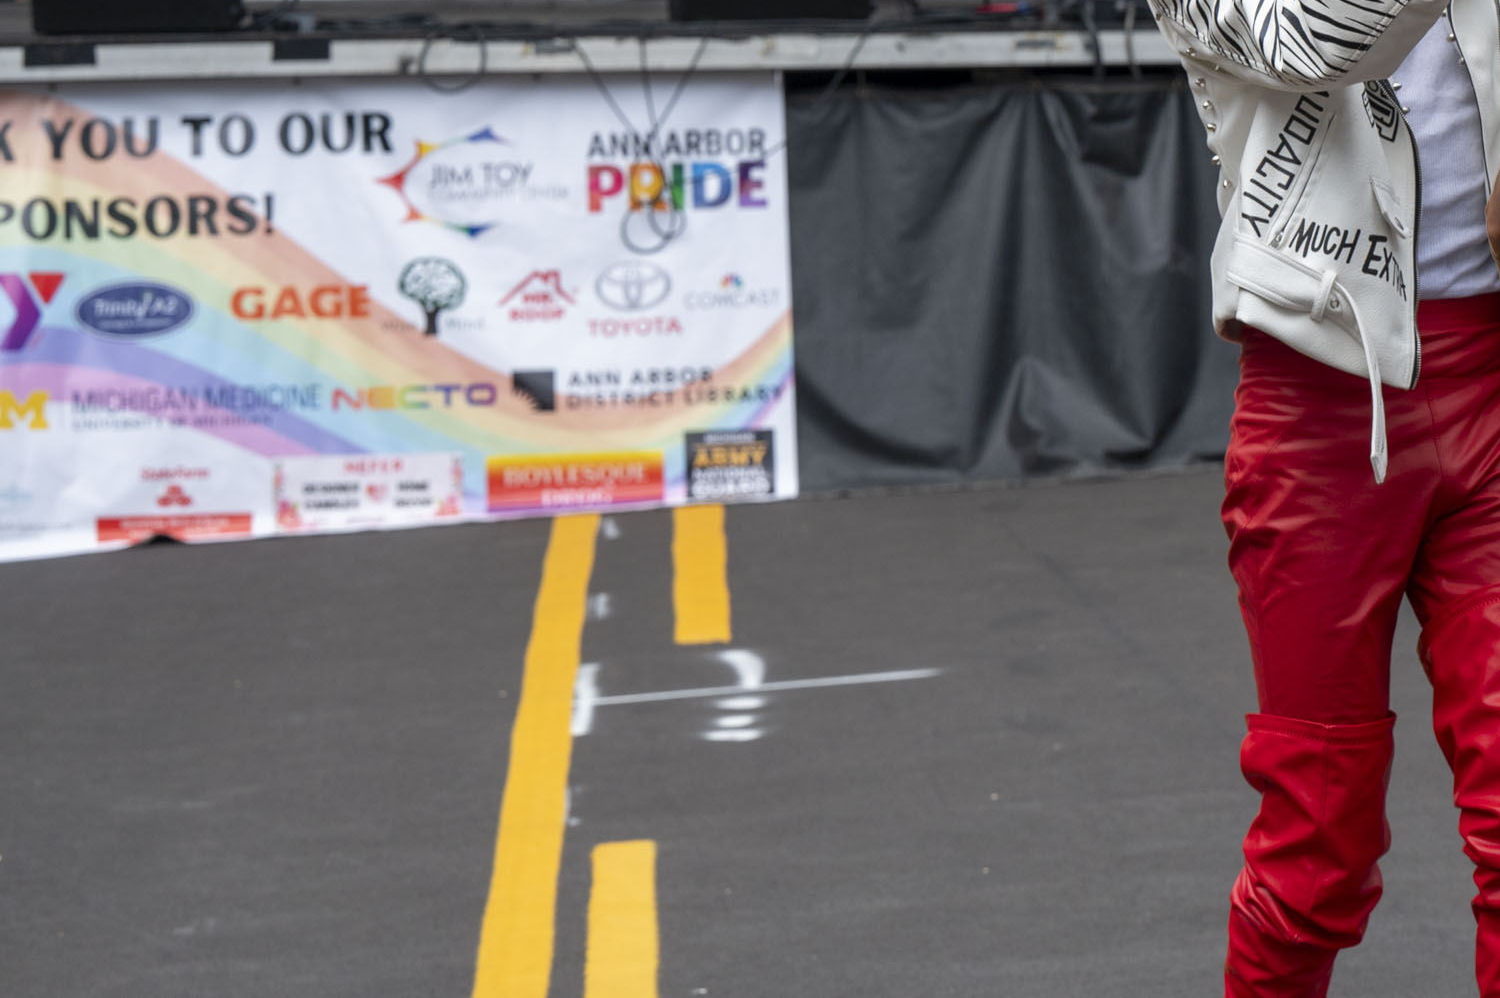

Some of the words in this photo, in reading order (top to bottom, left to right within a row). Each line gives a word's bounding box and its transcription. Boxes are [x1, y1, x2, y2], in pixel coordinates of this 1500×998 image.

[41, 116, 159, 162] YOU
[181, 113, 255, 157] TO
[278, 111, 394, 156] OUR
[587, 131, 654, 159] ANN
[661, 128, 768, 158] ARBOR
[430, 164, 473, 190] JIM
[481, 161, 534, 188] TOY
[1241, 91, 1329, 238] UDACITY
[588, 160, 767, 212] PRIDE
[1289, 218, 1361, 264] MUCH
[230, 284, 371, 321] GAGE
[686, 290, 778, 310] COMCAST
[588, 316, 684, 337] TOYOTA
[567, 371, 620, 388] ANN
[630, 366, 714, 385] ARBOR
[71, 387, 200, 414] MICHIGAN
[204, 383, 324, 411] MEDICINE
[331, 382, 498, 411] NECTO
[566, 391, 675, 410] DISTRICT
[684, 384, 782, 406] LIBRARY
[693, 443, 767, 468] ARMY
